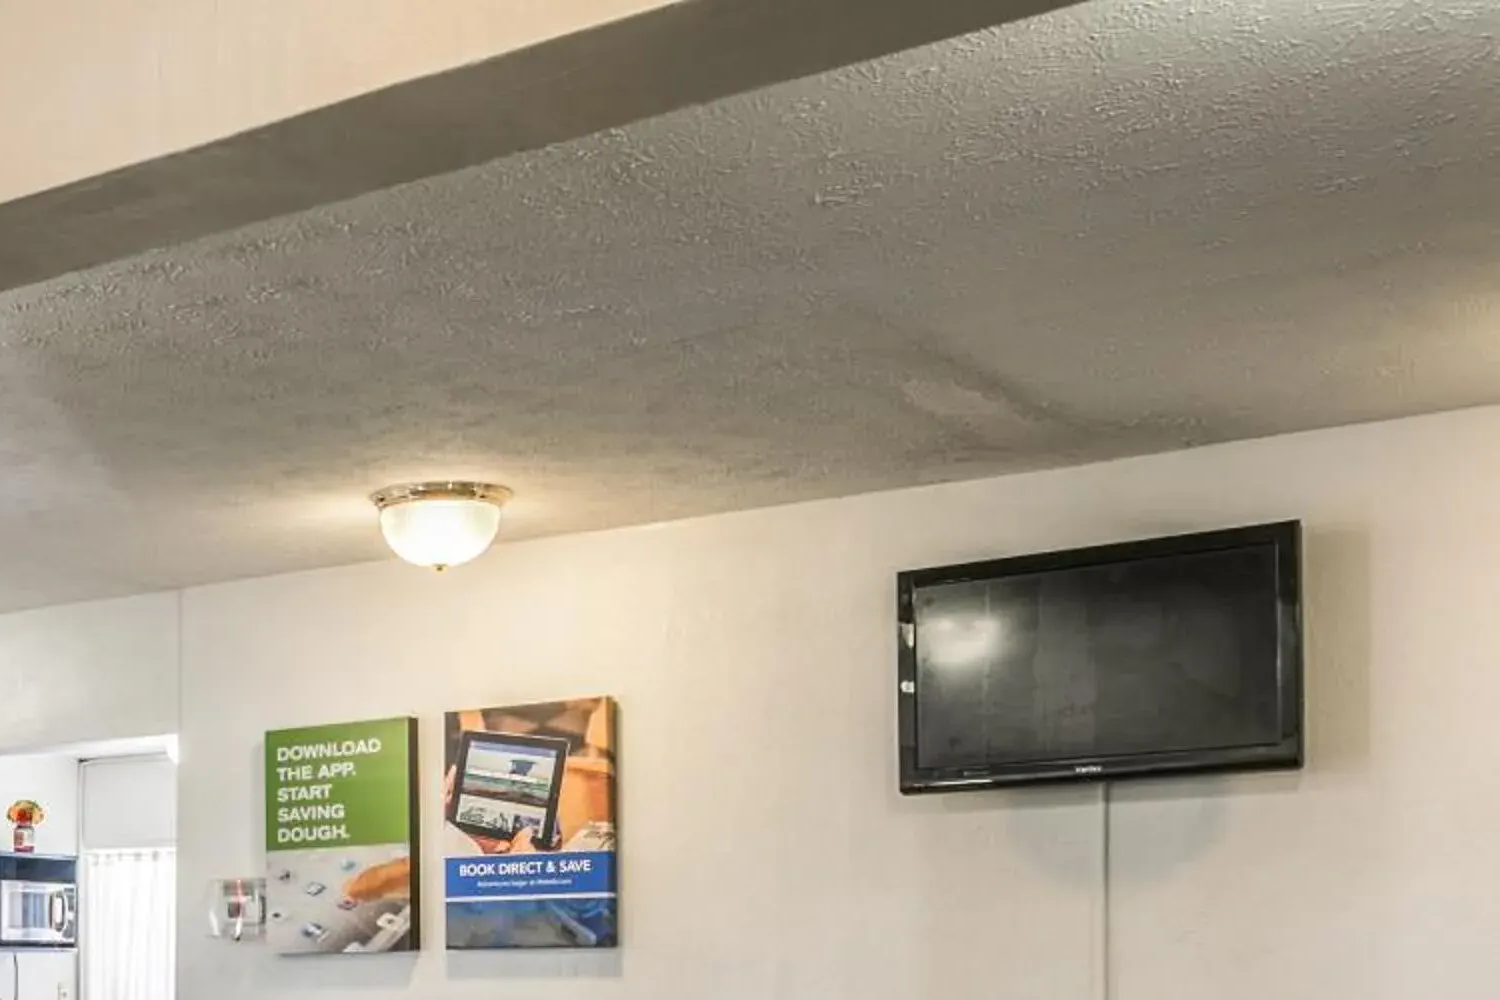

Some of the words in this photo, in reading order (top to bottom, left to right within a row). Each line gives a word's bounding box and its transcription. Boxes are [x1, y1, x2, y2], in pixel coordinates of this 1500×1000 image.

[277, 738, 381, 762] DOWNLOAD
[276, 765, 313, 781] THE
[317, 761, 357, 779] APP.
[277, 784, 332, 803] START
[277, 804, 345, 824] SAVING
[277, 825, 351, 844] DOUGH.
[459, 863, 495, 878] BOOK
[498, 861, 543, 876] DIRECT
[545, 860, 556, 873] &
[559, 859, 591, 873] SAVE
